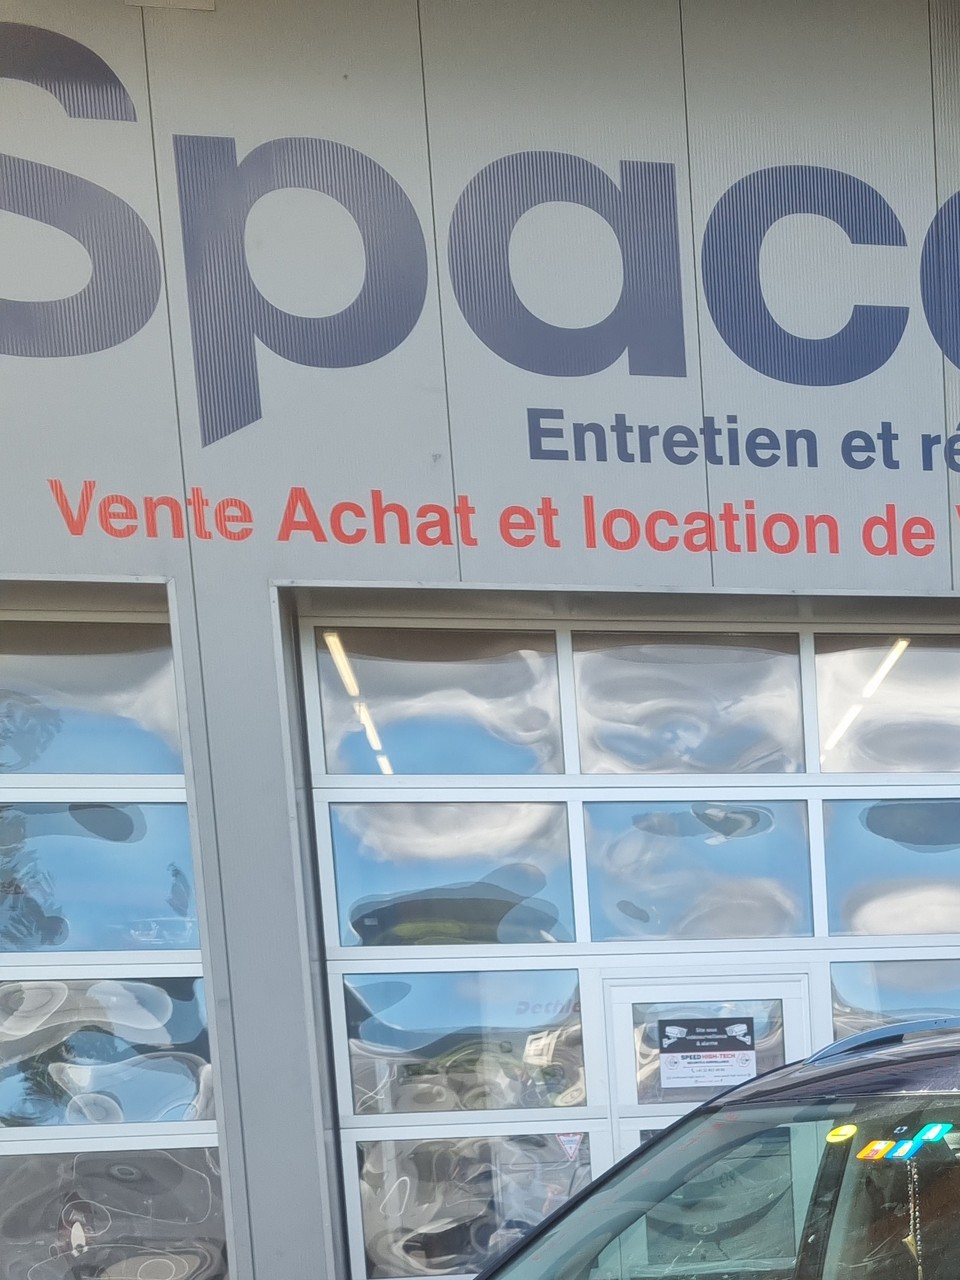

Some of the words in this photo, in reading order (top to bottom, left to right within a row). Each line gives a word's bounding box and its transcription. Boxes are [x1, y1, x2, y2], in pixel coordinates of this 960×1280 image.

[526, 407, 818, 468] Entretien
[840, 418, 901, 471] et
[47, 478, 254, 542] Vente
[277, 486, 478, 548] Achat
[498, 496, 562, 550] et
[583, 495, 839, 556] location
[861, 504, 937, 557] de
